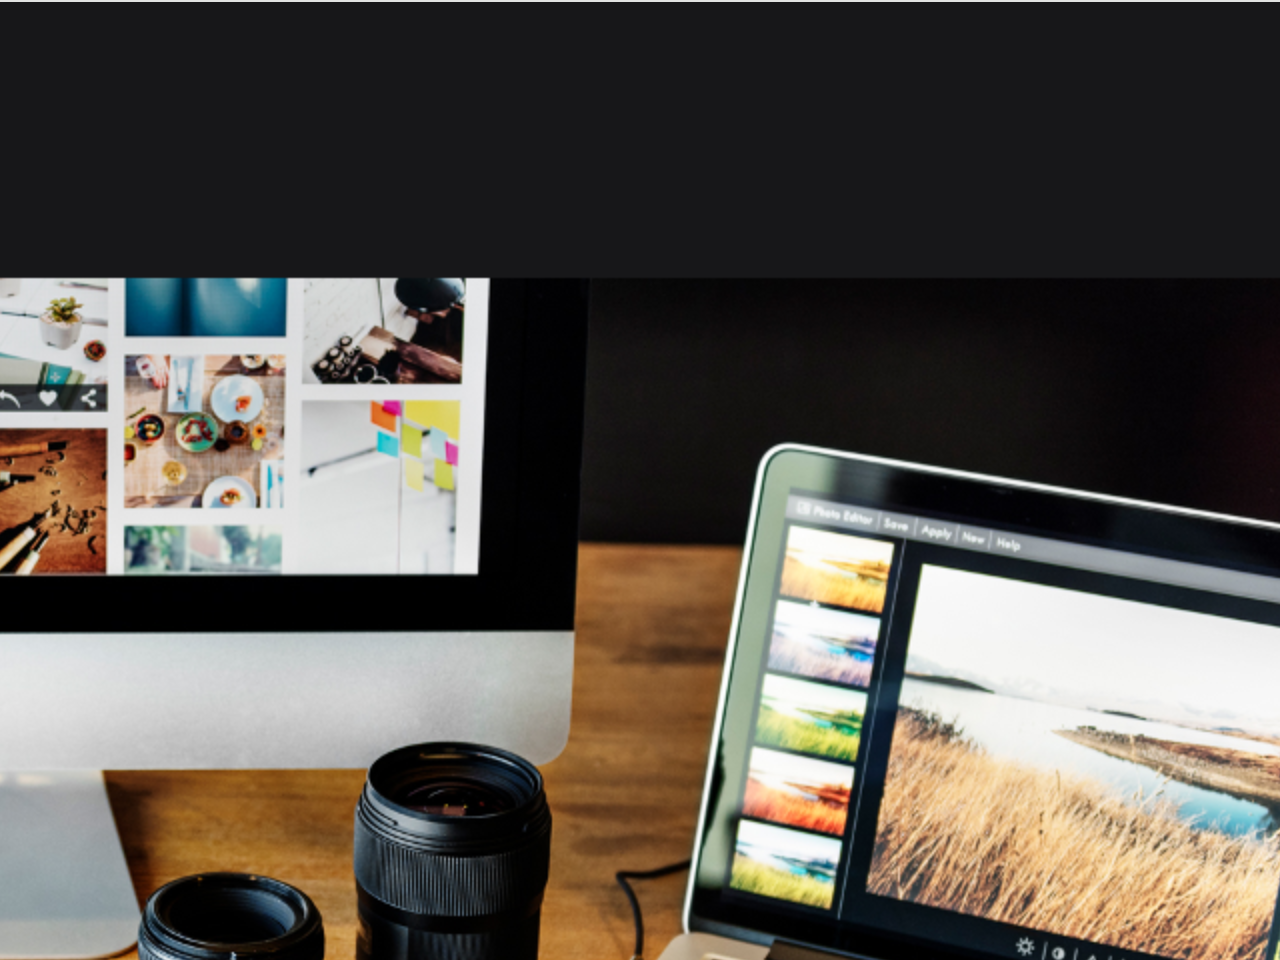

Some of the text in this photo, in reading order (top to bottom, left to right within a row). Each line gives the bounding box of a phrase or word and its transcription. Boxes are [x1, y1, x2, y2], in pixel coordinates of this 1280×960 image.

[813, 504, 1021, 552] Photo Editor Save Apply New Help
